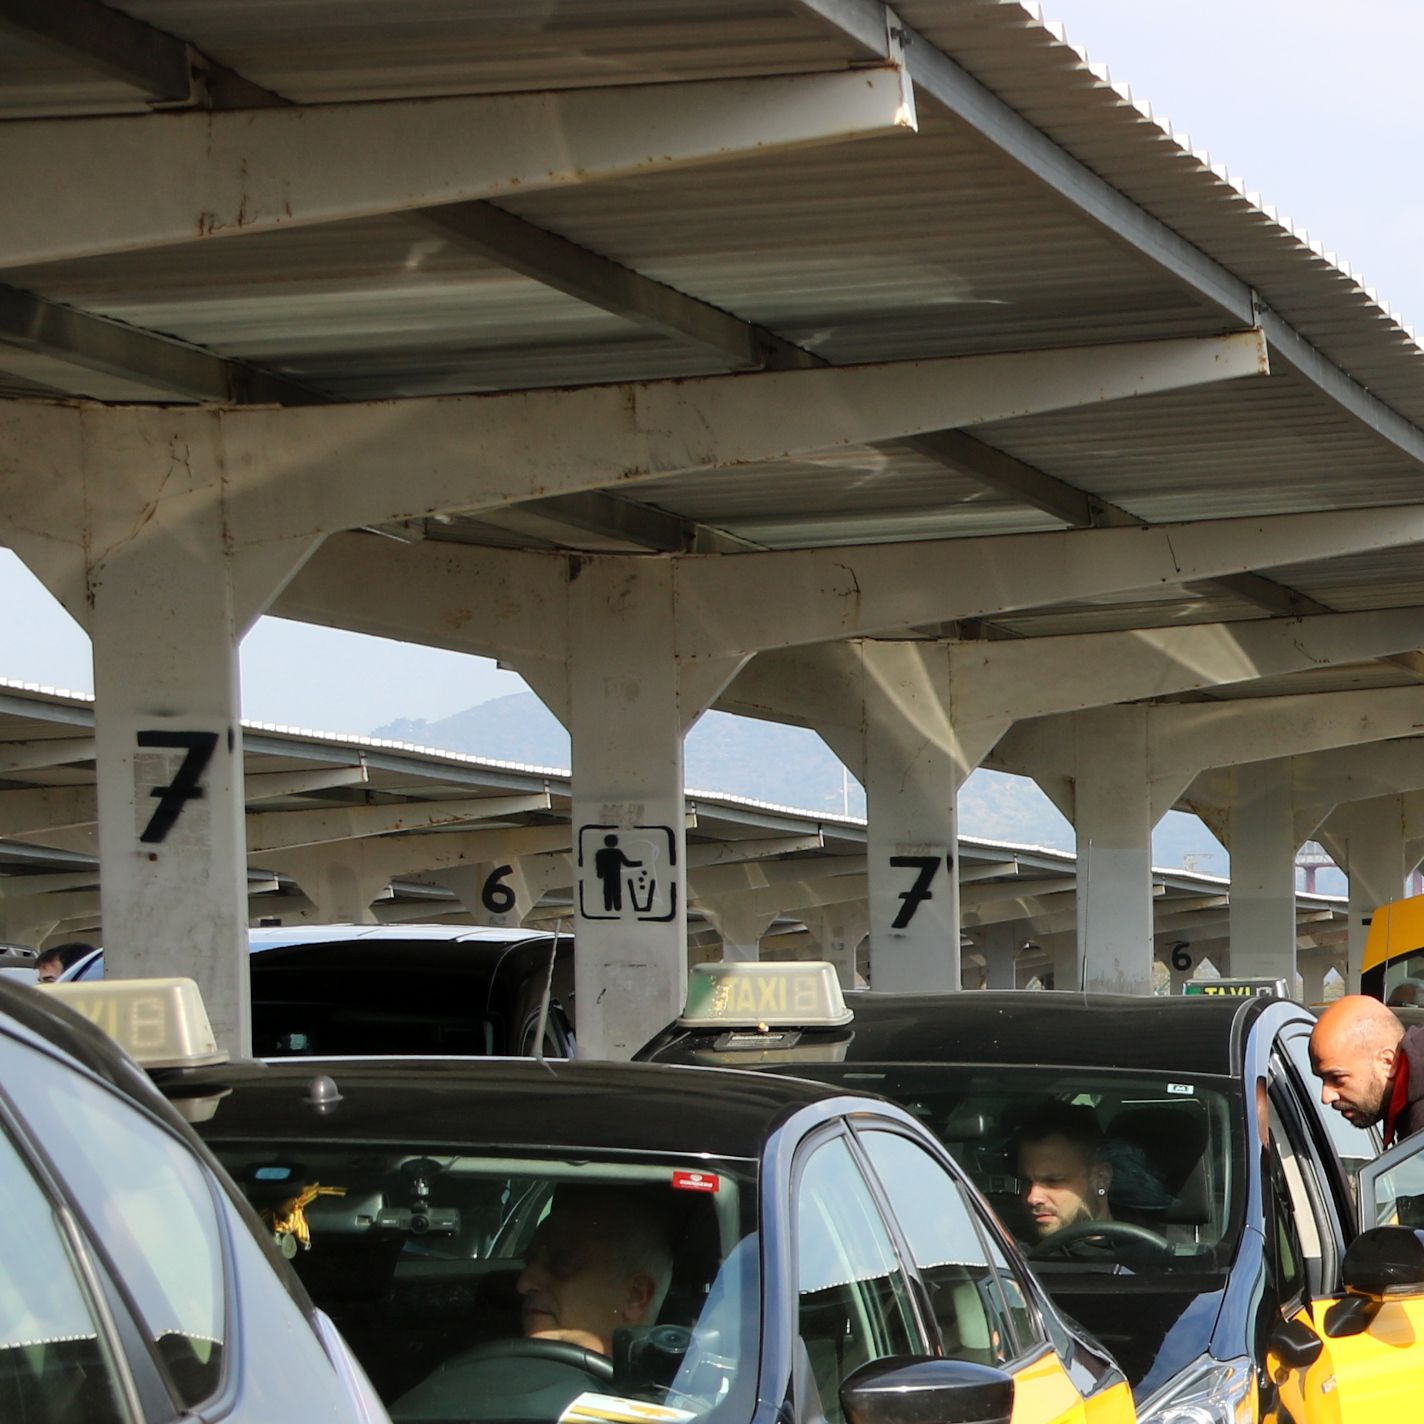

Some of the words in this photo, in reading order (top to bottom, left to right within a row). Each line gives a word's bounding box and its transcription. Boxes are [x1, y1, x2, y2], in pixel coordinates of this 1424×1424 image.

[136, 730, 220, 844] 7
[481, 864, 517, 914] 6
[888, 856, 942, 929] 7
[1171, 940, 1193, 971] 6
[722, 975, 787, 1012] TAXI
